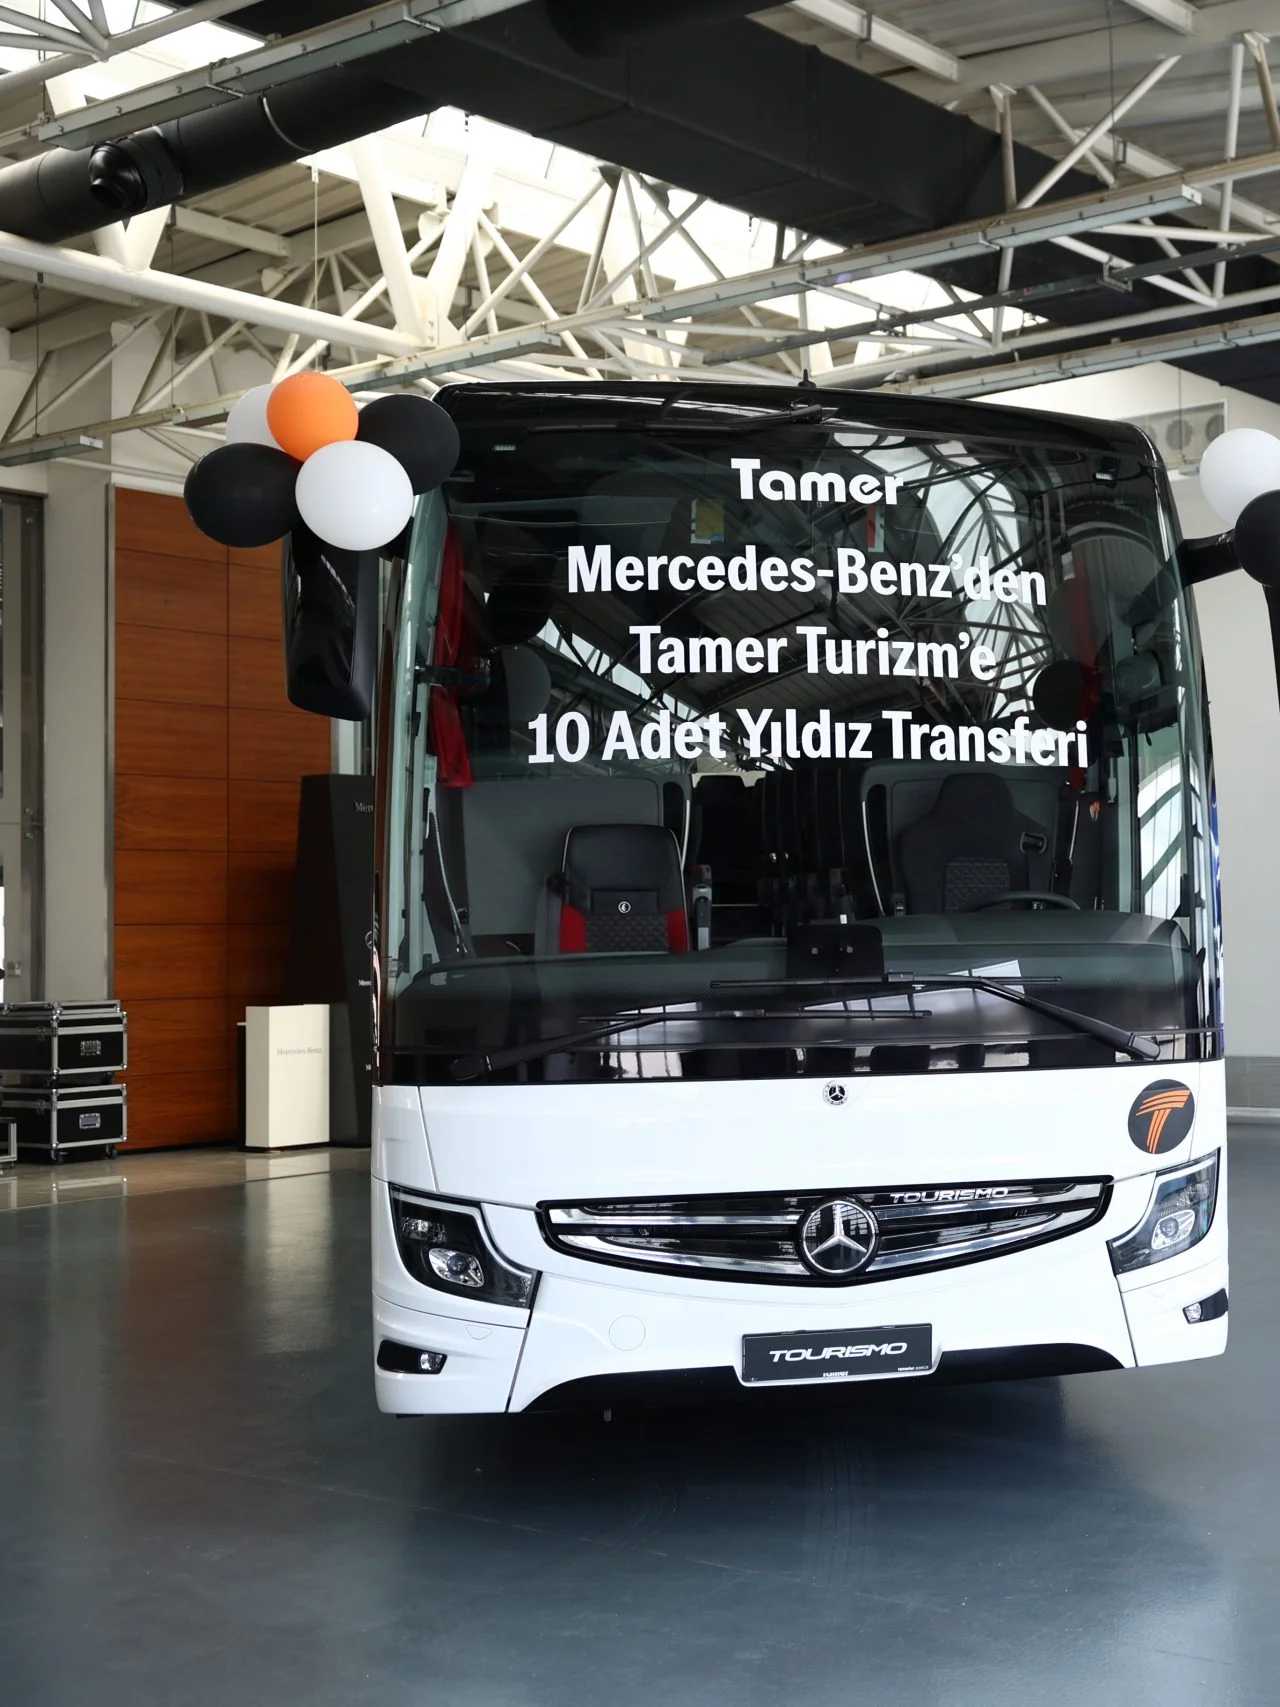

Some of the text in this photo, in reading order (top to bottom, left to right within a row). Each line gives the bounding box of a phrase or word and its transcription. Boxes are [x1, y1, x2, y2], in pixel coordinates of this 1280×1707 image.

[731, 458, 904, 505] Tamer
[567, 544, 1047, 605] Mercedes-Benz’den
[629, 625, 997, 680] Tamer Turizm’e
[527, 708, 1089, 768] 10 Adet Yıldız Transferi
[889, 1187, 1009, 1204] TOURISMO
[769, 1342, 908, 1363] TOURISMO
